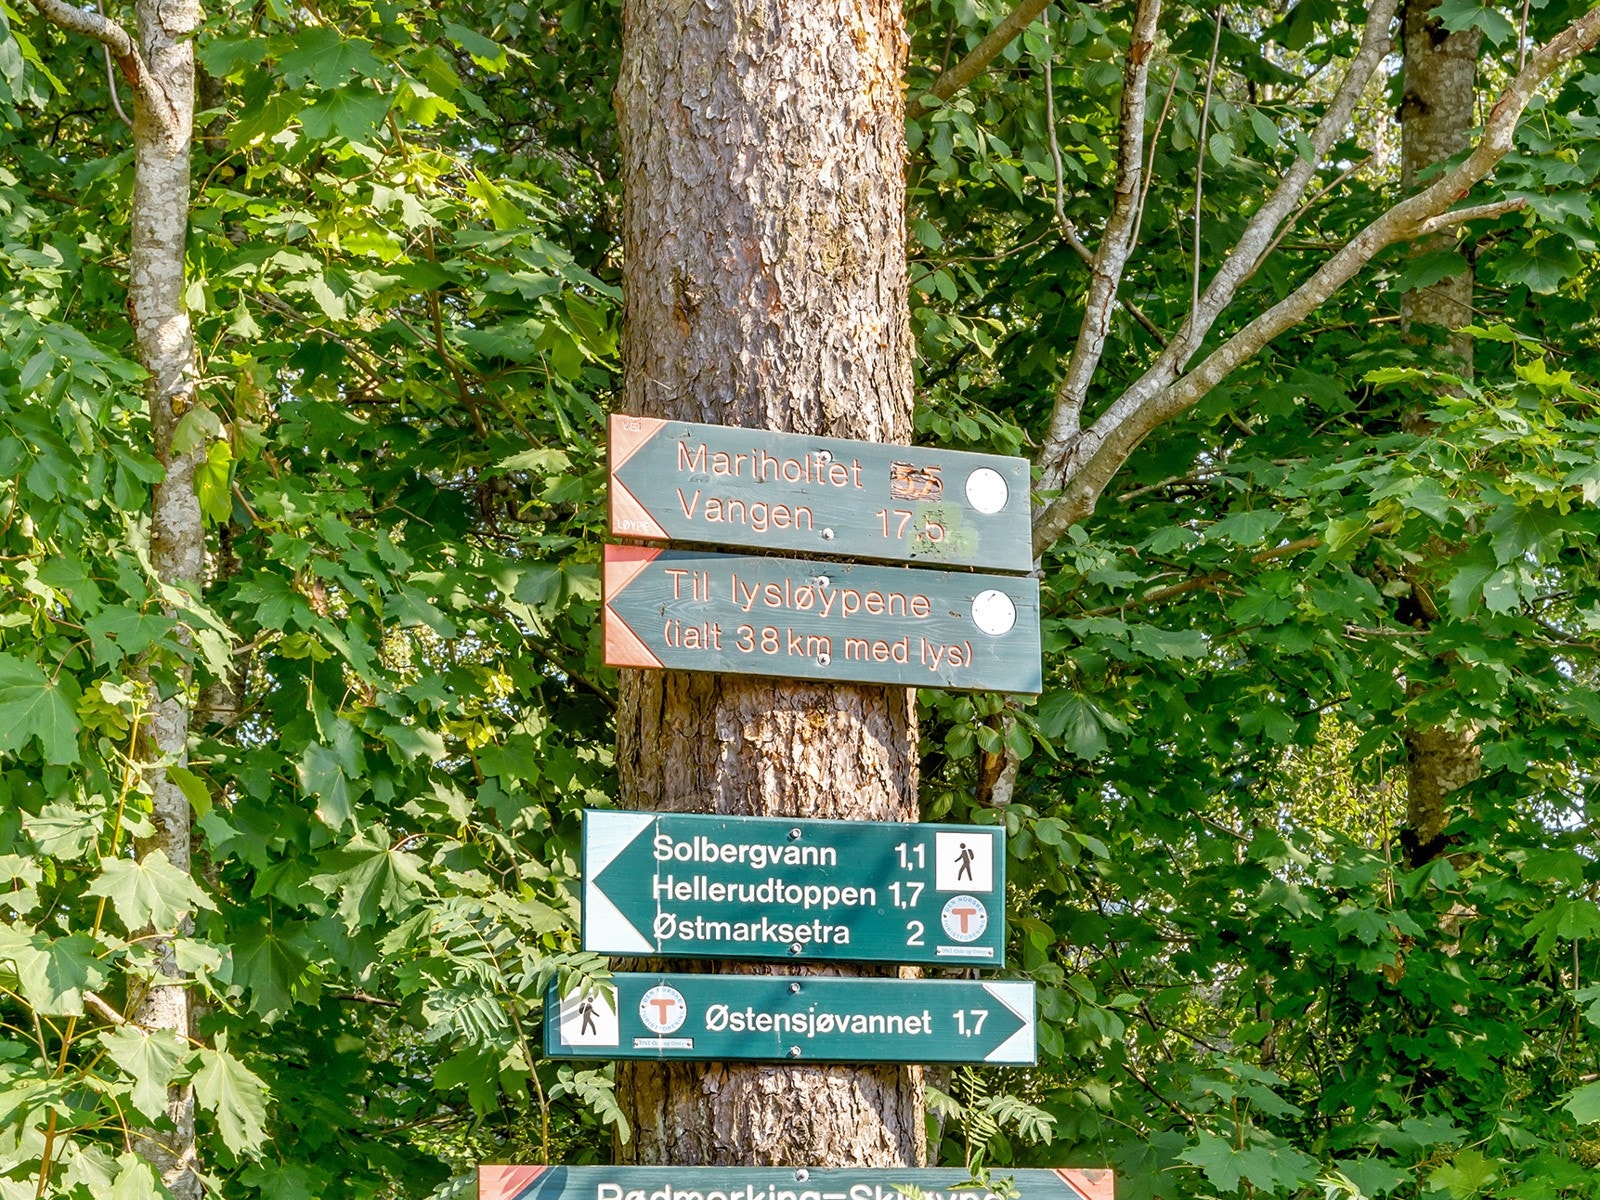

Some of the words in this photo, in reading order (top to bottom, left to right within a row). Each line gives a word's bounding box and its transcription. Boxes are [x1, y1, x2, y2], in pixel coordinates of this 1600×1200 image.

[677, 440, 863, 489] Mariholtet
[617, 519, 650, 532] LØYPE
[676, 487, 814, 533] Vangen
[664, 568, 709, 602] Til
[732, 573, 931, 618] lysløypene
[664, 618, 722, 651] (ialt
[845, 636, 909, 664] med
[921, 636, 973, 672] lys)
[653, 834, 837, 869] Solbergvann
[894, 842, 925, 871] 1,1
[653, 874, 876, 910] Hellerudtoppen
[888, 881, 925, 910] 1,7
[653, 912, 850, 944] Østmarksetra
[906, 920, 925, 946] 2
[705, 1004, 932, 1038] Østensjøvannet
[952, 1009, 989, 1038] 1,7
